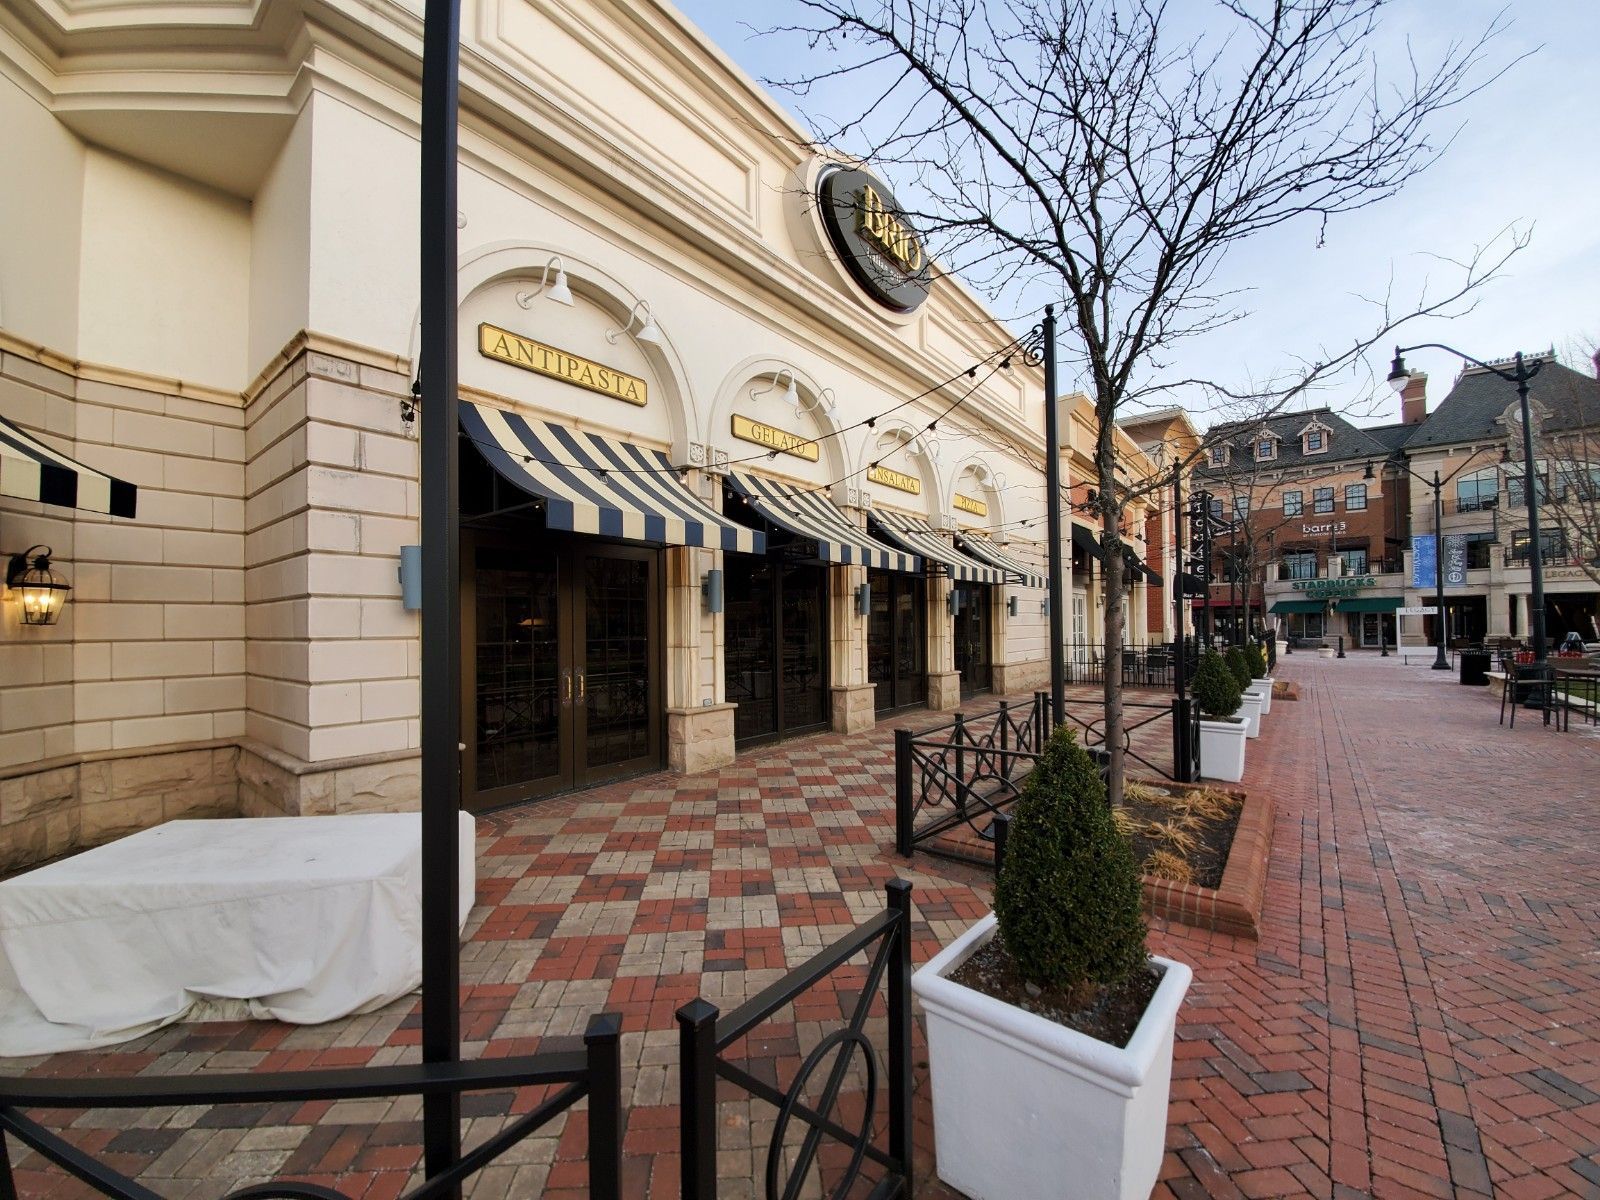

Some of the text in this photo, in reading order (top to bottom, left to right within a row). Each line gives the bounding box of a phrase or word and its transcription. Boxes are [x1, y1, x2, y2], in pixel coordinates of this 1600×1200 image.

[492, 333, 640, 400] ANTIPASTA
[751, 423, 805, 454] GELATO
[1544, 568, 1586, 578] LEGAC
[1292, 578, 1376, 590] STARBUCKS
